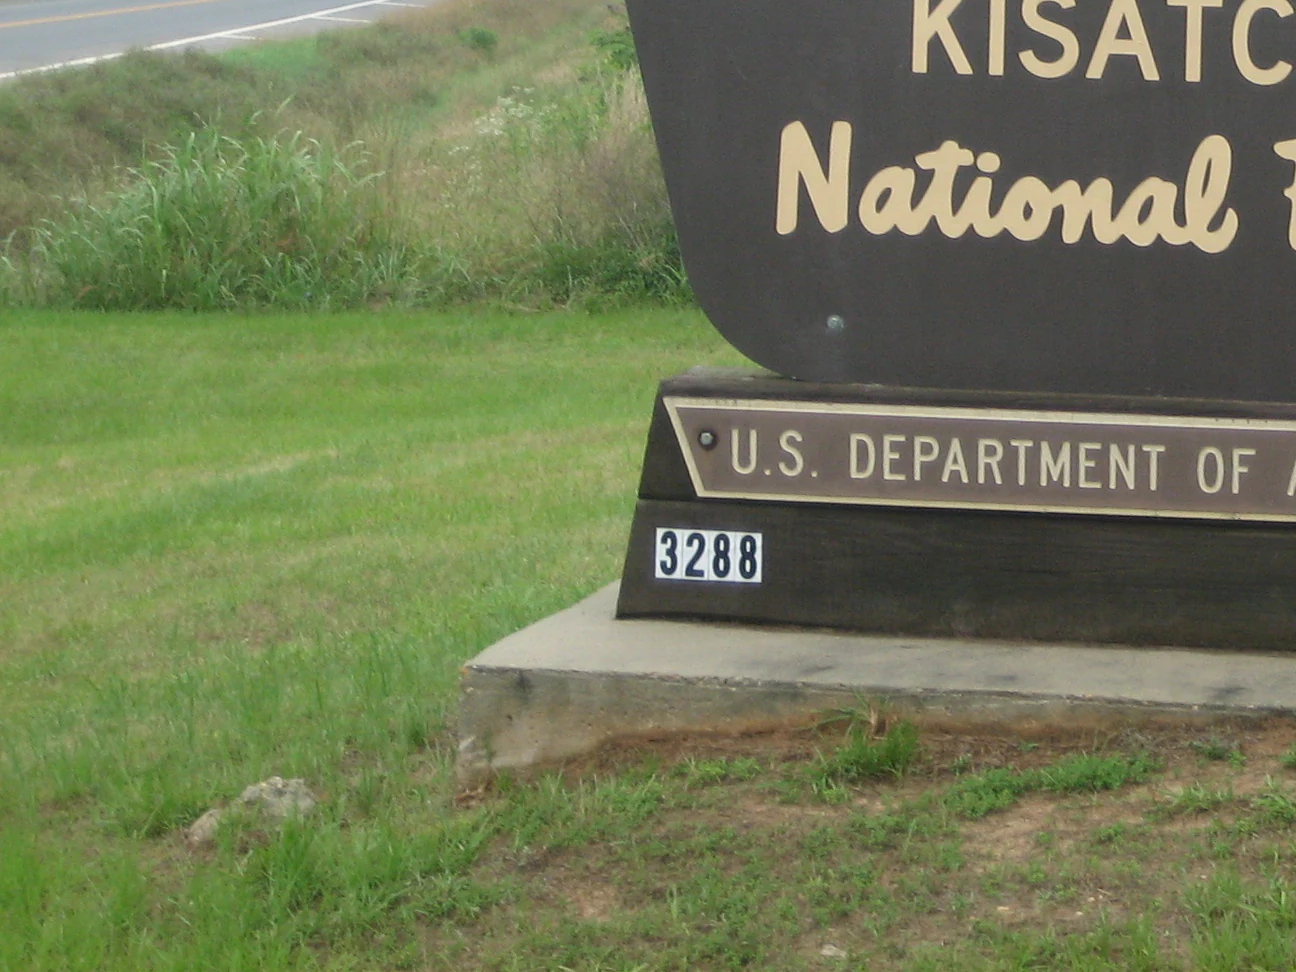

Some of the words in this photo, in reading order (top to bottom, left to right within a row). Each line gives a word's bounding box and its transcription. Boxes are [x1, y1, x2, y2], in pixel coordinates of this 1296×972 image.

[776, 120, 1239, 254] National
[731, 428, 818, 478] U.S.
[849, 432, 1166, 491] DEPARTMENT
[1196, 446, 1256, 495] OF
[659, 530, 758, 580] 3288
